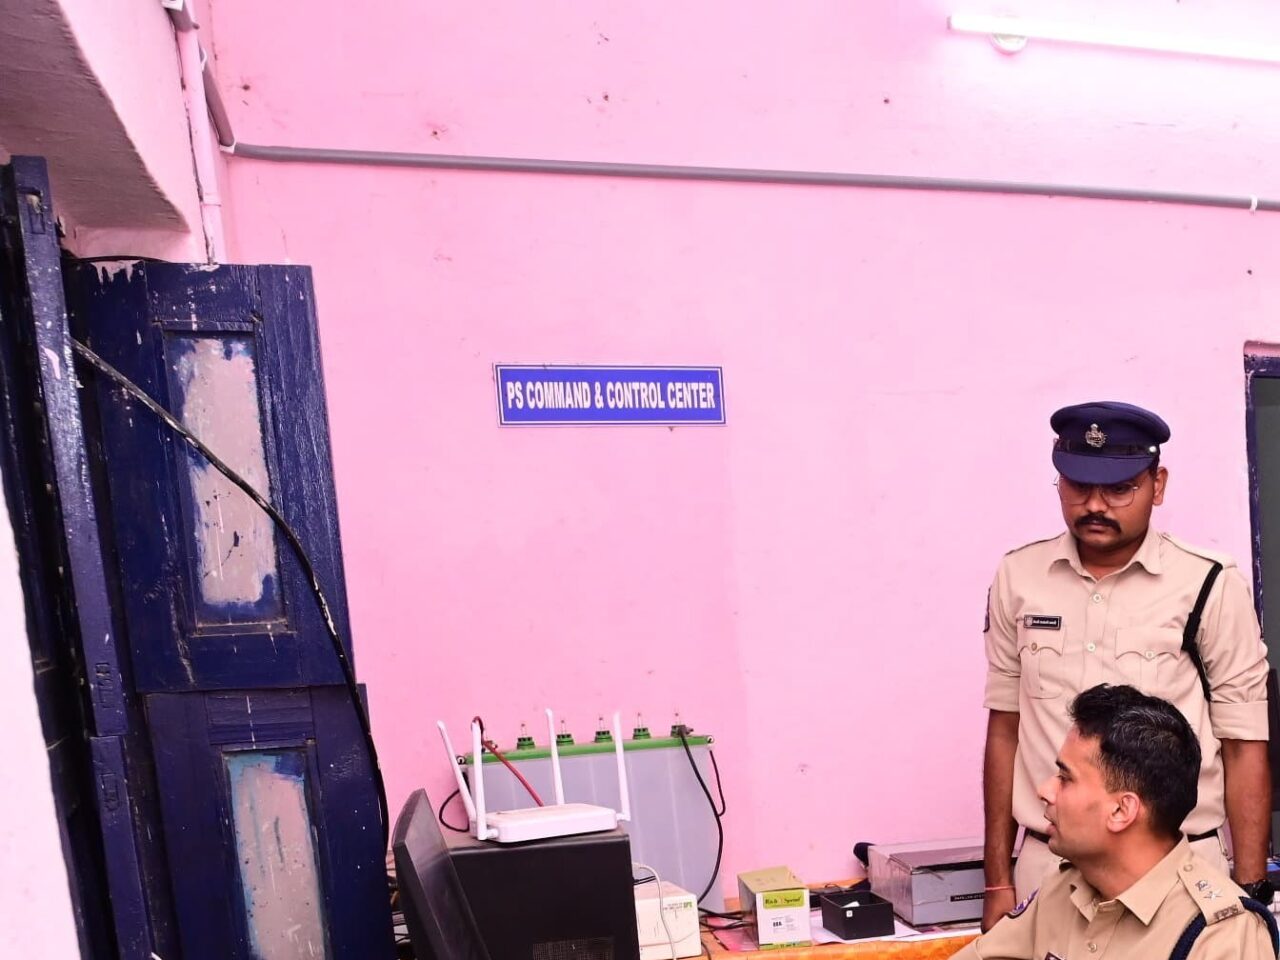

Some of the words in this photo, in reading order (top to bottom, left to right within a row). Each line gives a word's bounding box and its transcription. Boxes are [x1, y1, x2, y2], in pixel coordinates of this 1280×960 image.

[506, 381, 523, 409] PS
[526, 381, 591, 409] COMMAND
[594, 381, 604, 409] &
[606, 381, 665, 409] CONTROL
[667, 381, 716, 409] CENTER
